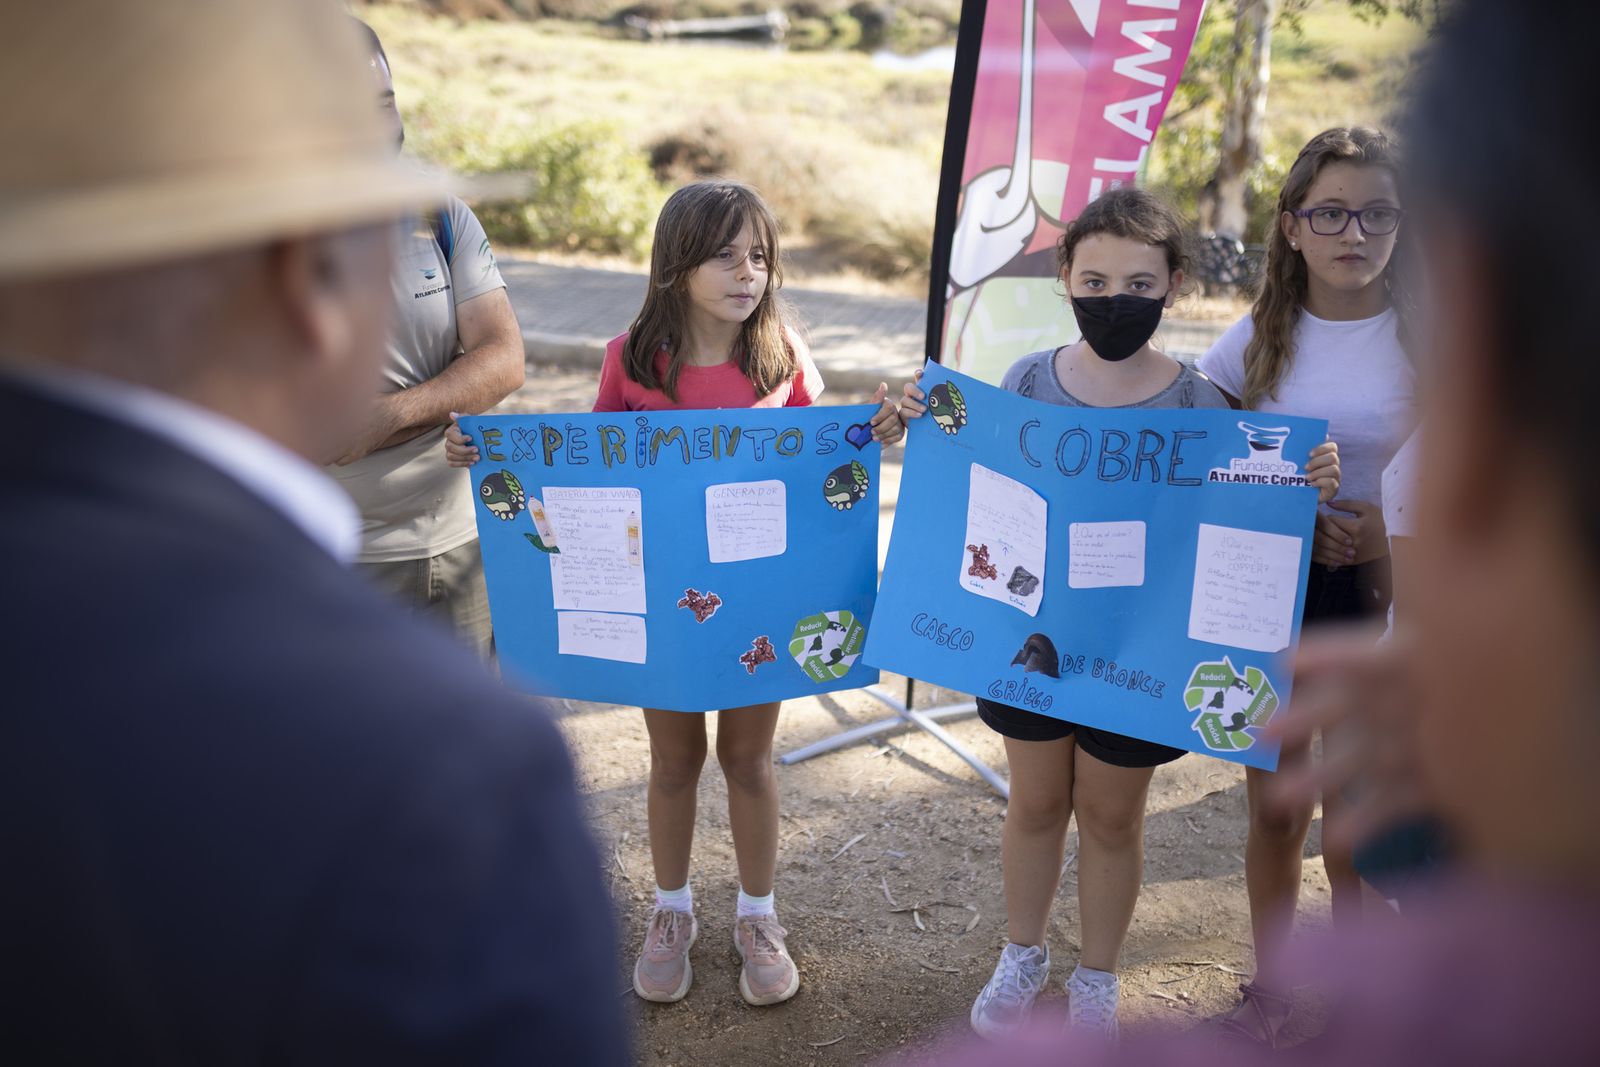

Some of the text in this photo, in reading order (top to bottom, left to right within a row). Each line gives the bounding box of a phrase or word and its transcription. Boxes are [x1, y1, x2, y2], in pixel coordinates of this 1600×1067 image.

[477, 416, 840, 470] EXPERIMENTOS
[1019, 418, 1207, 487] COBRE
[1210, 471, 1312, 487] ATLANTIC COPPE
[1233, 459, 1295, 473] Fundación
[712, 487, 778, 498] GENERADOR
[799, 621, 823, 633] Reducir
[910, 612, 975, 651] CASCO
[1060, 653, 1167, 698] DE BRONCE
[1199, 672, 1227, 682] Reducir
[987, 677, 1054, 712] GRIEGO
[1204, 717, 1223, 745] Reciclar
